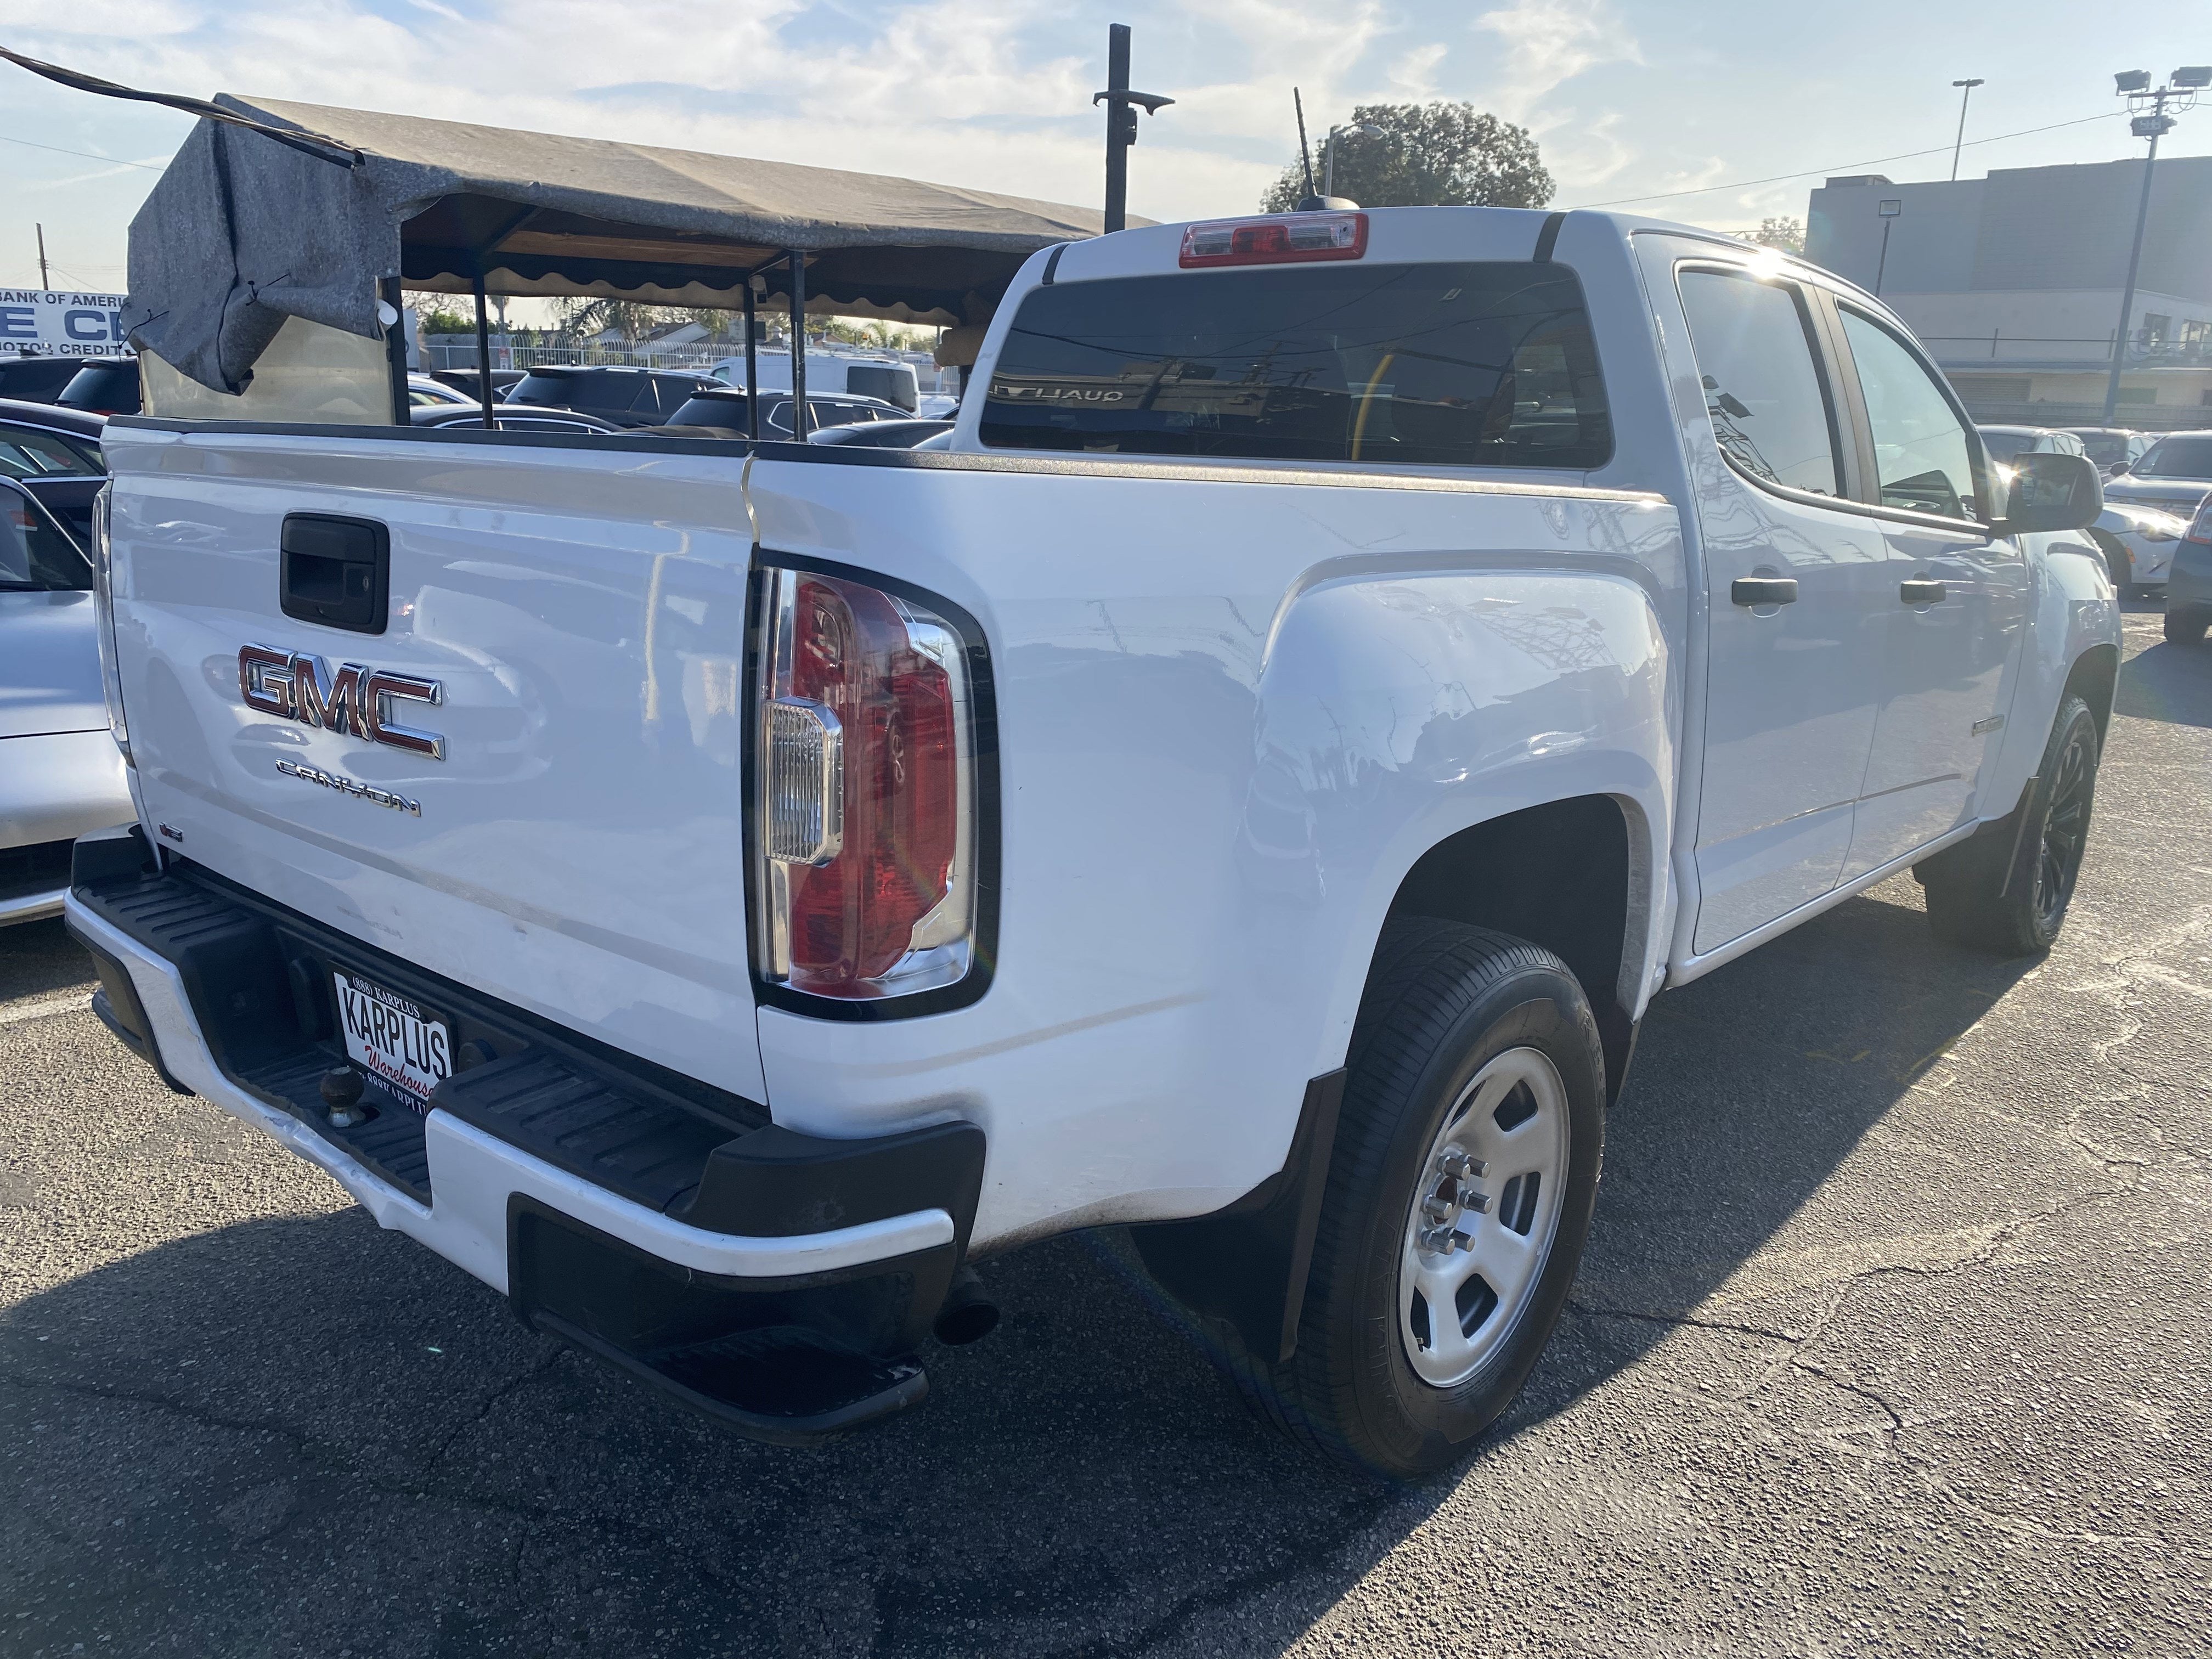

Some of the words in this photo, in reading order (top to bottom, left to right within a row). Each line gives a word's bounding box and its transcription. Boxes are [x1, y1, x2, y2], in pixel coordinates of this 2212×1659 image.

[0, 291, 39, 303] ANK
[45, 294, 66, 304] OF
[0, 342, 53, 355] OTO
[59, 344, 119, 356] CREDIT
[238, 641, 446, 761] GMC
[275, 757, 422, 817] CANYON
[353, 977, 373, 996] (888)
[374, 986, 420, 1018] KARPLUS
[342, 986, 447, 1081] KARPLUS
